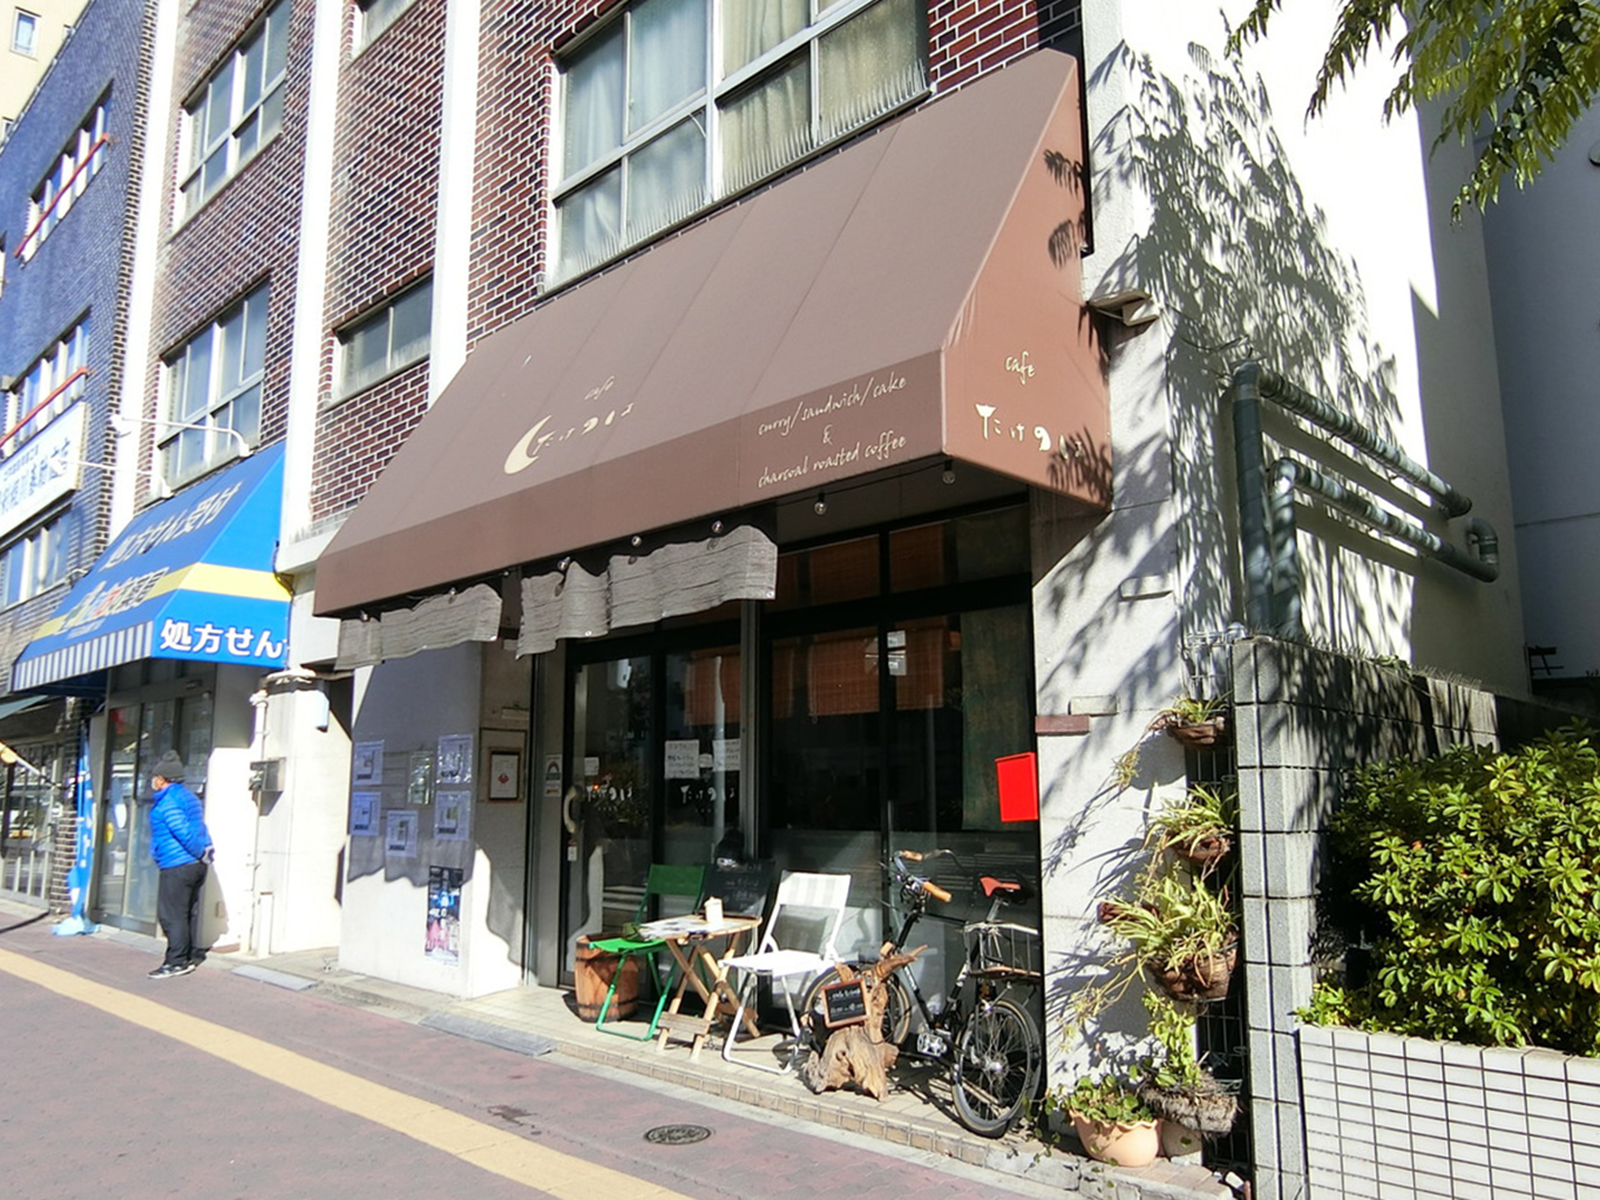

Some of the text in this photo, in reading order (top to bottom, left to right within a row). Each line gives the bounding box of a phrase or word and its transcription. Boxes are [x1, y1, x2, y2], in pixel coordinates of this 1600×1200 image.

[1005, 351, 1036, 385] cafe
[758, 371, 906, 436] curry/sandwich/cake
[822, 424, 834, 445] &
[758, 430, 906, 488] charcoal roasted coffee
[159, 618, 288, 659] 処方せん
